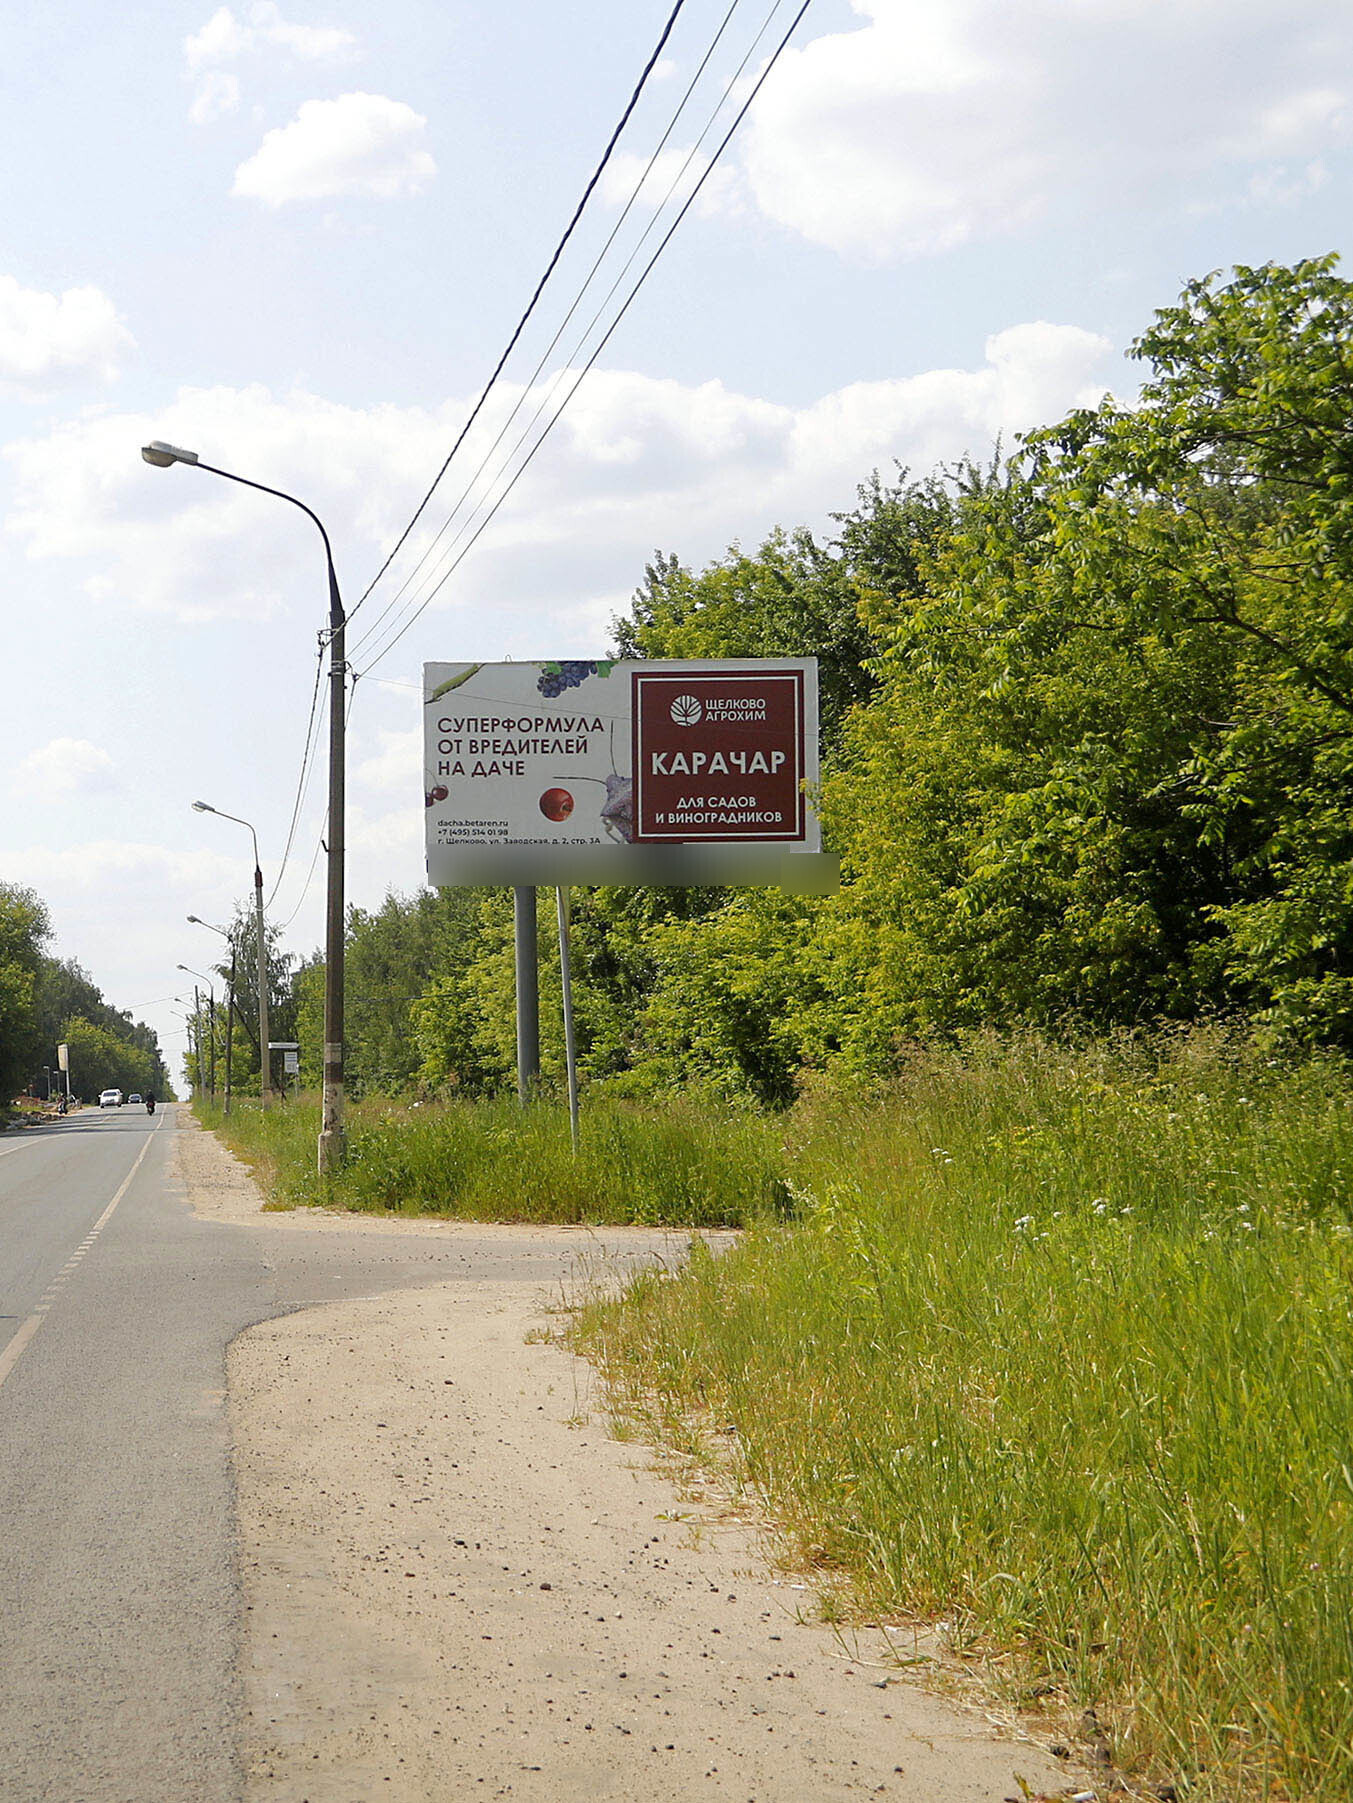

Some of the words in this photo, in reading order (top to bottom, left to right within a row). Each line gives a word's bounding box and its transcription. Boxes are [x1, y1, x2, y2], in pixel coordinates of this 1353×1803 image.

[705, 698, 766, 710] ЩЕЛКОВО
[705, 710, 766, 721] АГРОХИМ
[437, 717, 604, 733] СУПЕРФОРМУЛА
[437, 739, 463, 755] ОТ
[469, 735, 588, 756] ВРЕДИТЕЛЕЙ
[438, 760, 465, 775] НА
[471, 760, 525, 778] ДАЧЕ
[651, 751, 786, 775] КАРАЧАР
[676, 797, 704, 809] ДЛЯ
[707, 796, 757, 809] САДОВ
[437, 819, 509, 827] dacha.betaren.ru
[655, 813, 665, 824] И
[668, 811, 783, 824] ВИНОГРАДНИКОВ
[449, 828, 471, 837] (495)
